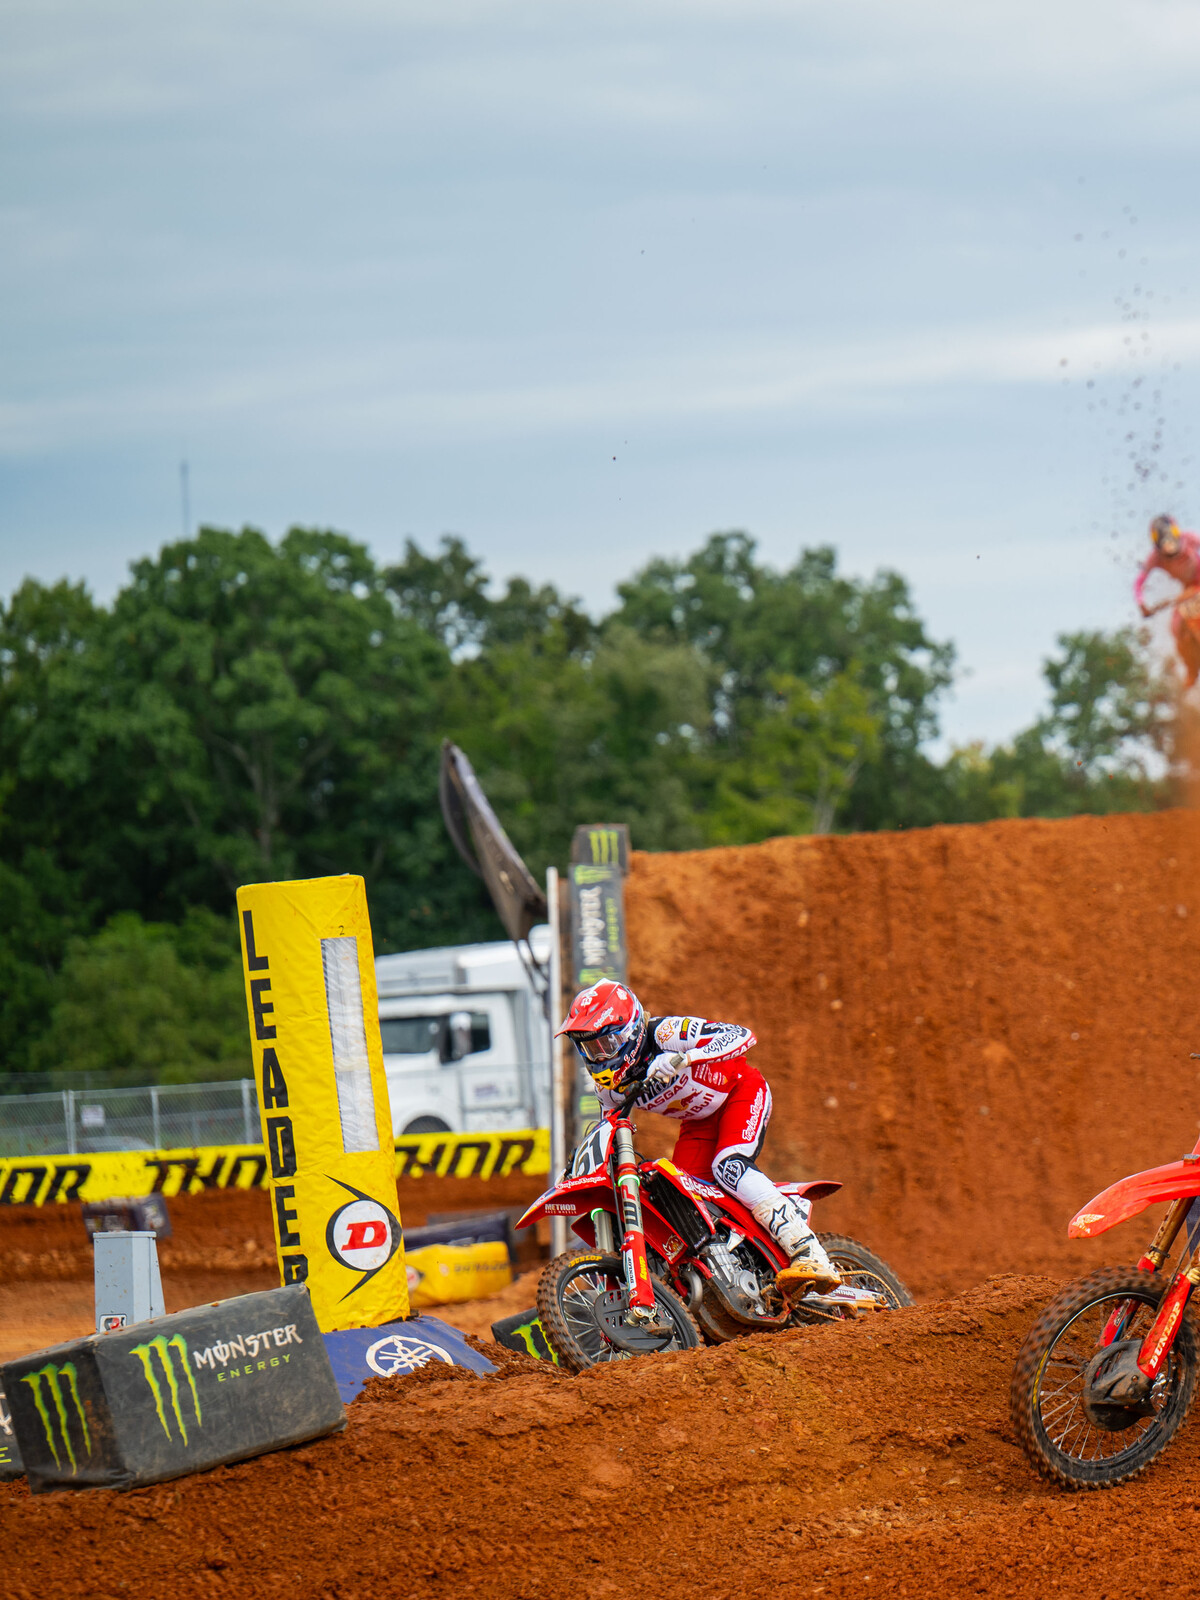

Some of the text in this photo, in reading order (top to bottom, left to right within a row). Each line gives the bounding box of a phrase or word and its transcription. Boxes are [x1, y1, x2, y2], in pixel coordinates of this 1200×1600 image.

[691, 1092, 715, 1114] Bull
[395, 1139, 535, 1176] HOR
[0, 1165, 91, 1205] OR
[145, 1153, 268, 1197] THO
[545, 1203, 577, 1211] METHOD
[341, 1220, 387, 1251] D
[568, 1255, 603, 1268] DUNLOP
[628, 1257, 636, 1284] DUNLOP
[193, 1323, 304, 1370] MONSTER
[1149, 1302, 1182, 1369] DUNLOP
[217, 1353, 292, 1383] ENERGY
